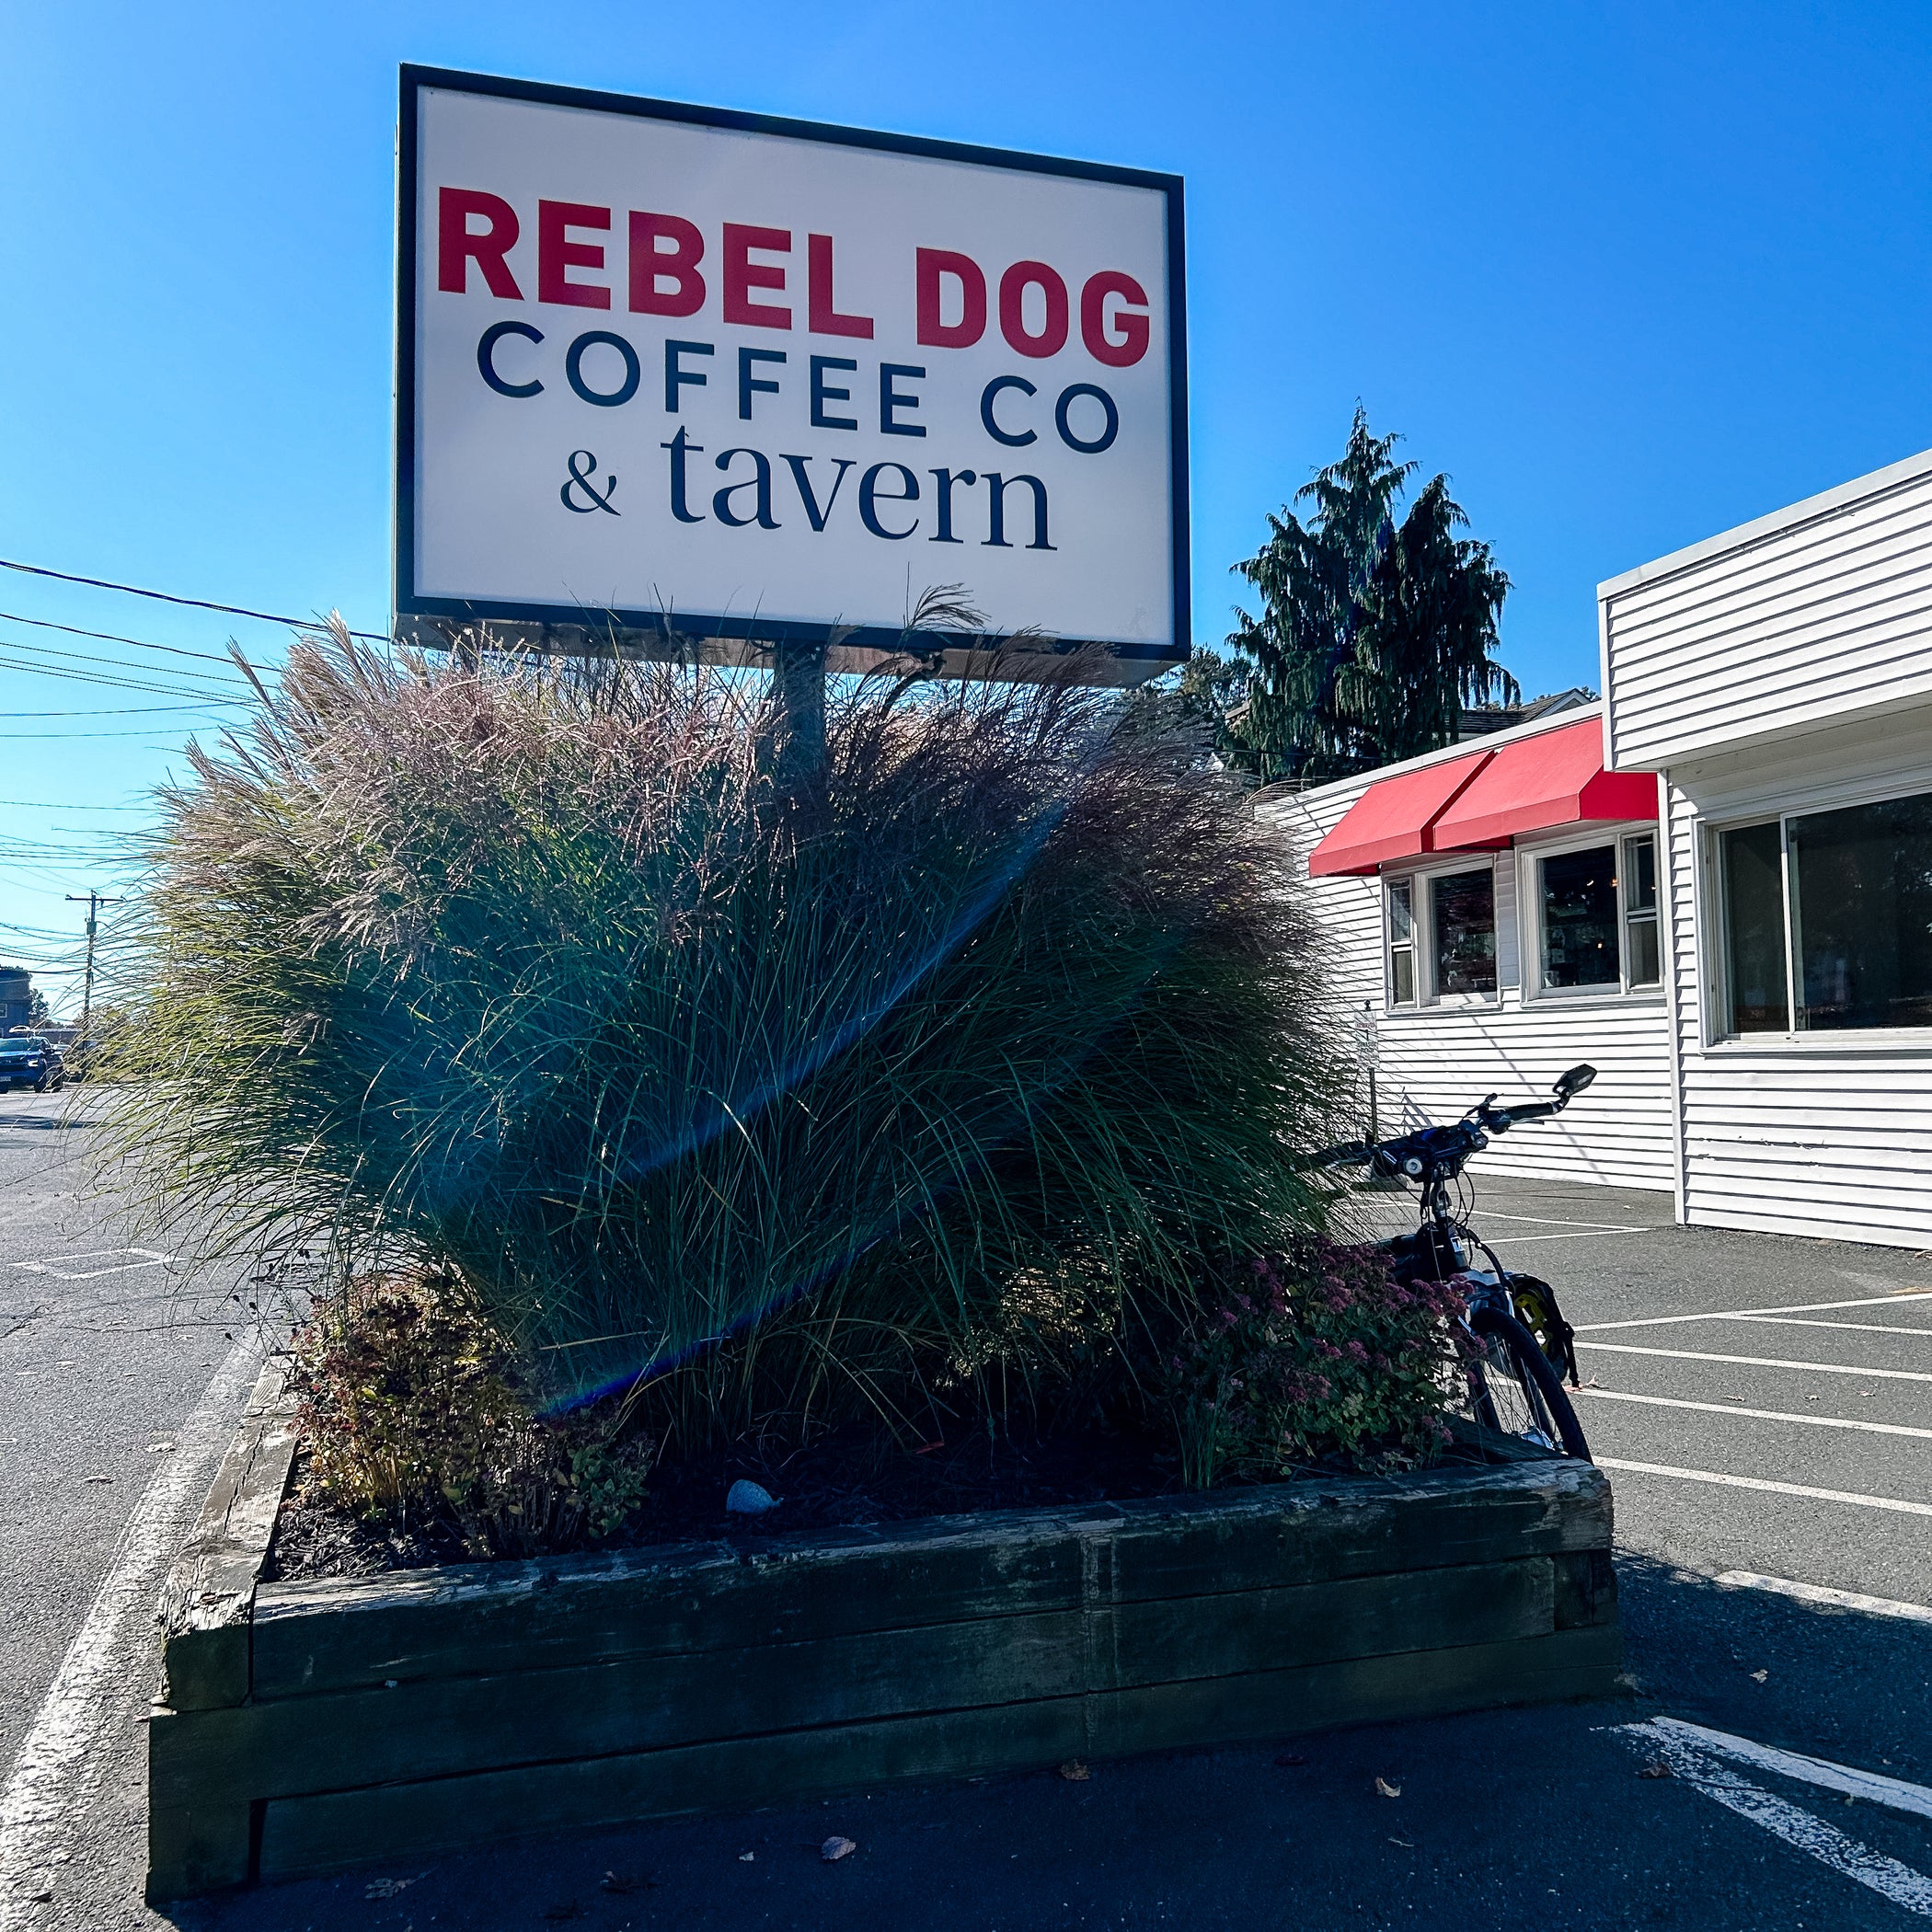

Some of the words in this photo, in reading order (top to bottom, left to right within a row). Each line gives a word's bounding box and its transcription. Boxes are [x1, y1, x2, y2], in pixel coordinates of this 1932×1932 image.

[438, 187, 874, 339] REBEL
[916, 247, 1150, 367] DOG
[477, 320, 927, 438] COFFEE
[980, 374, 1120, 454] CO
[559, 450, 622, 517] &
[660, 425, 1058, 551] tavern
